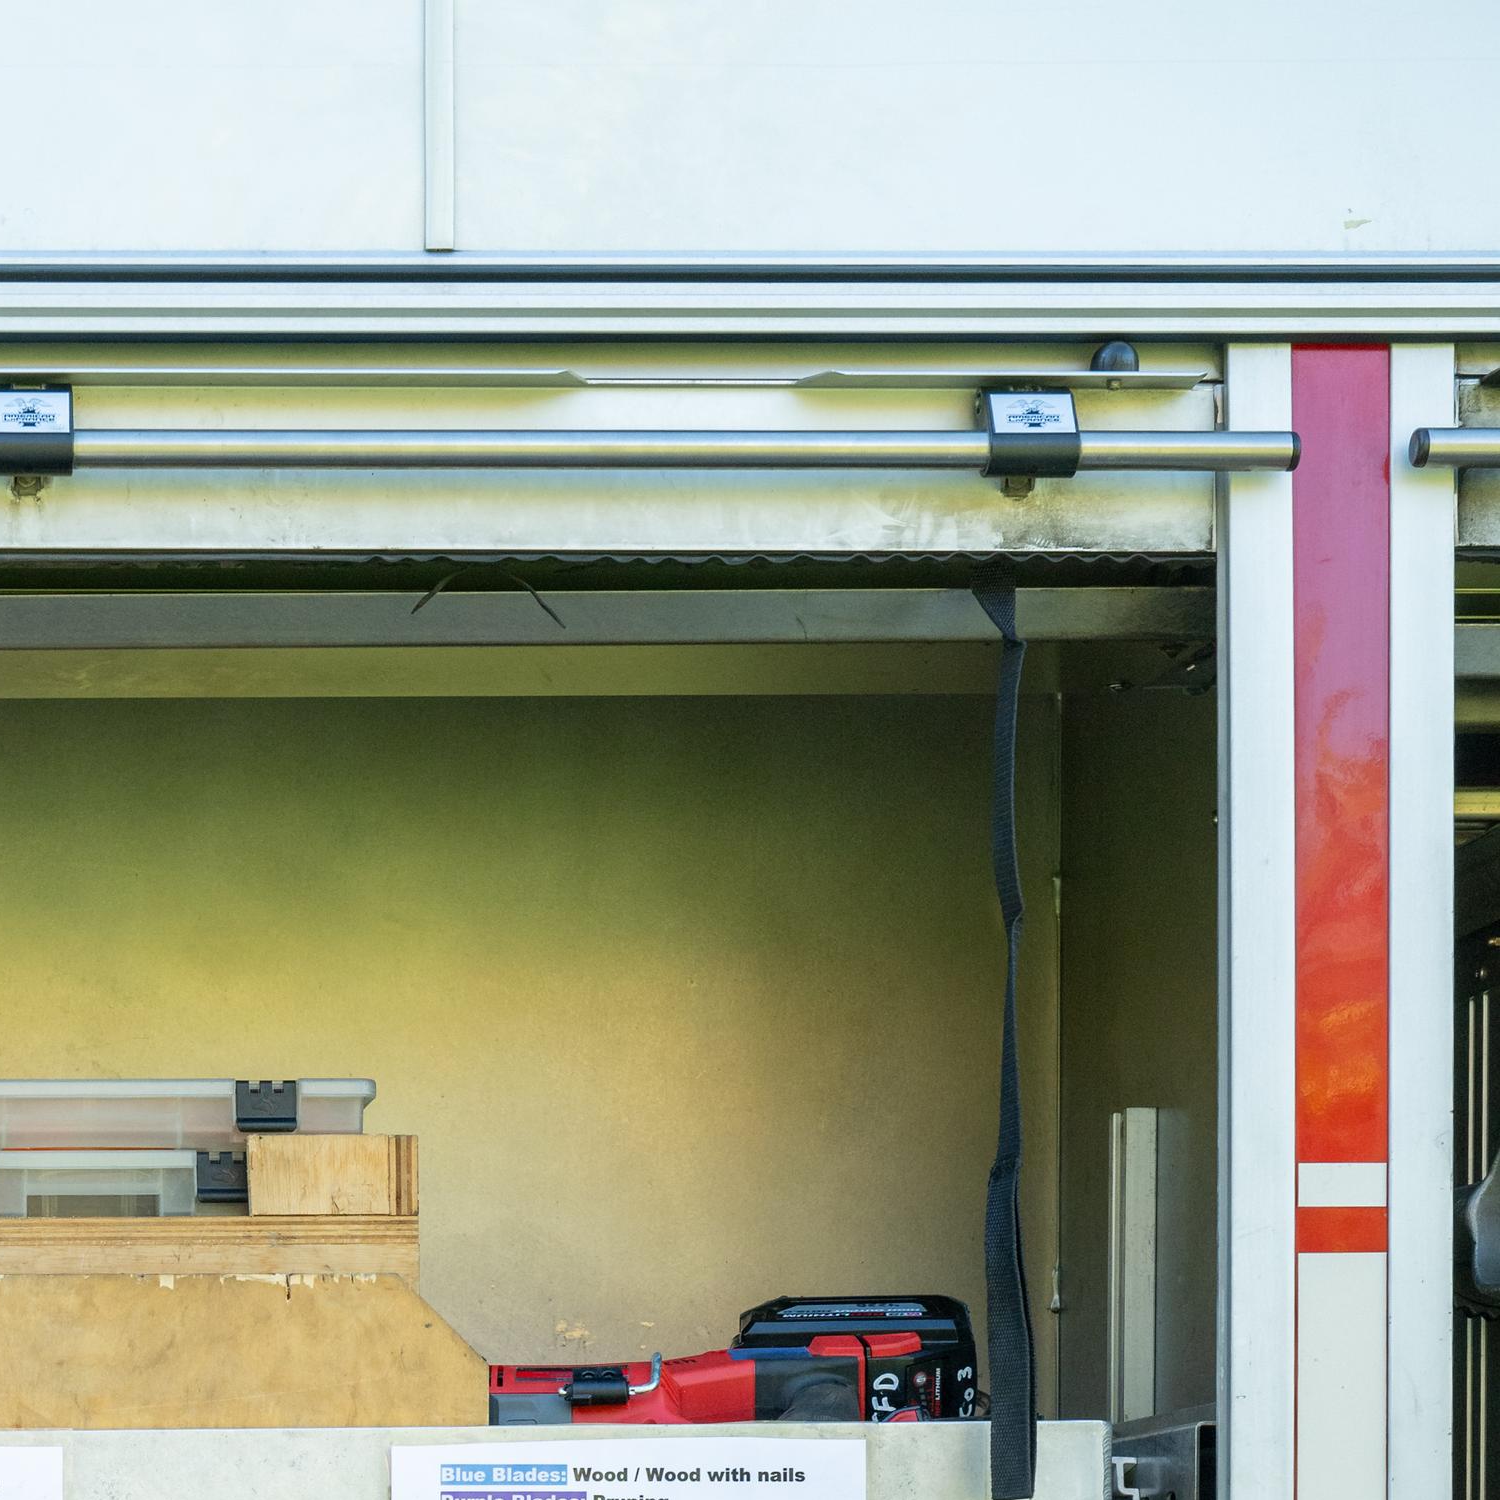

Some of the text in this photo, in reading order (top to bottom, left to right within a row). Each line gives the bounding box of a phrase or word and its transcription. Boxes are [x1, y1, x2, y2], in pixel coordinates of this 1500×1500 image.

[441, 1467, 485, 1482] Blue
[492, 1467, 567, 1482] Blades:
[573, 1467, 628, 1482] Wood
[646, 1467, 701, 1482] Wood
[707, 1467, 751, 1483] with
[757, 1467, 806, 1483] nails
